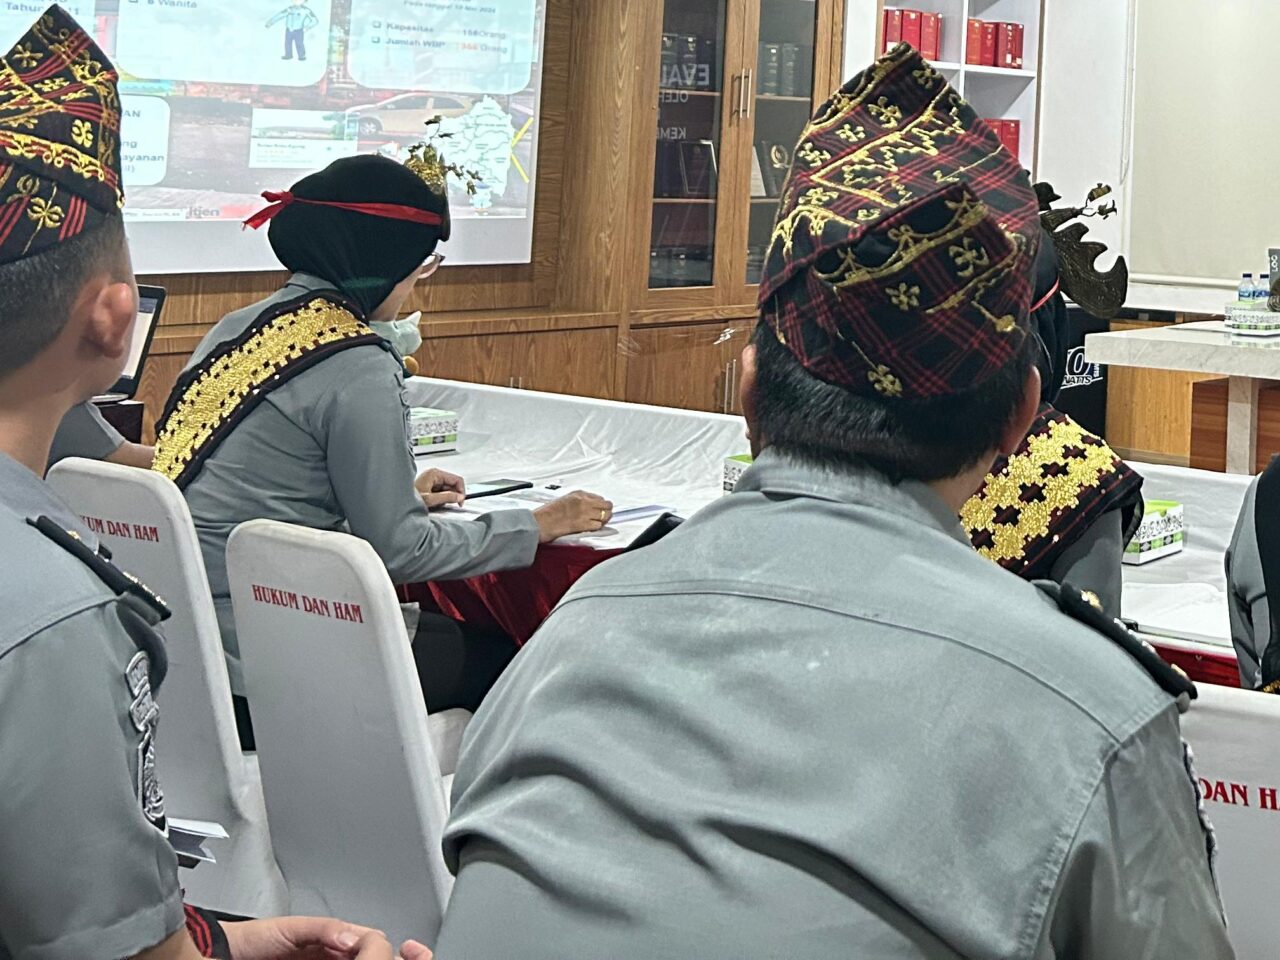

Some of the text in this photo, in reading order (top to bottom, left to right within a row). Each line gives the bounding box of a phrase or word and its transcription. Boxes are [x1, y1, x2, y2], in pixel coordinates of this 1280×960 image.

[106, 520, 131, 538] DAN
[133, 524, 160, 542] HAM
[252, 584, 364, 624] HUKUM DAN HAM
